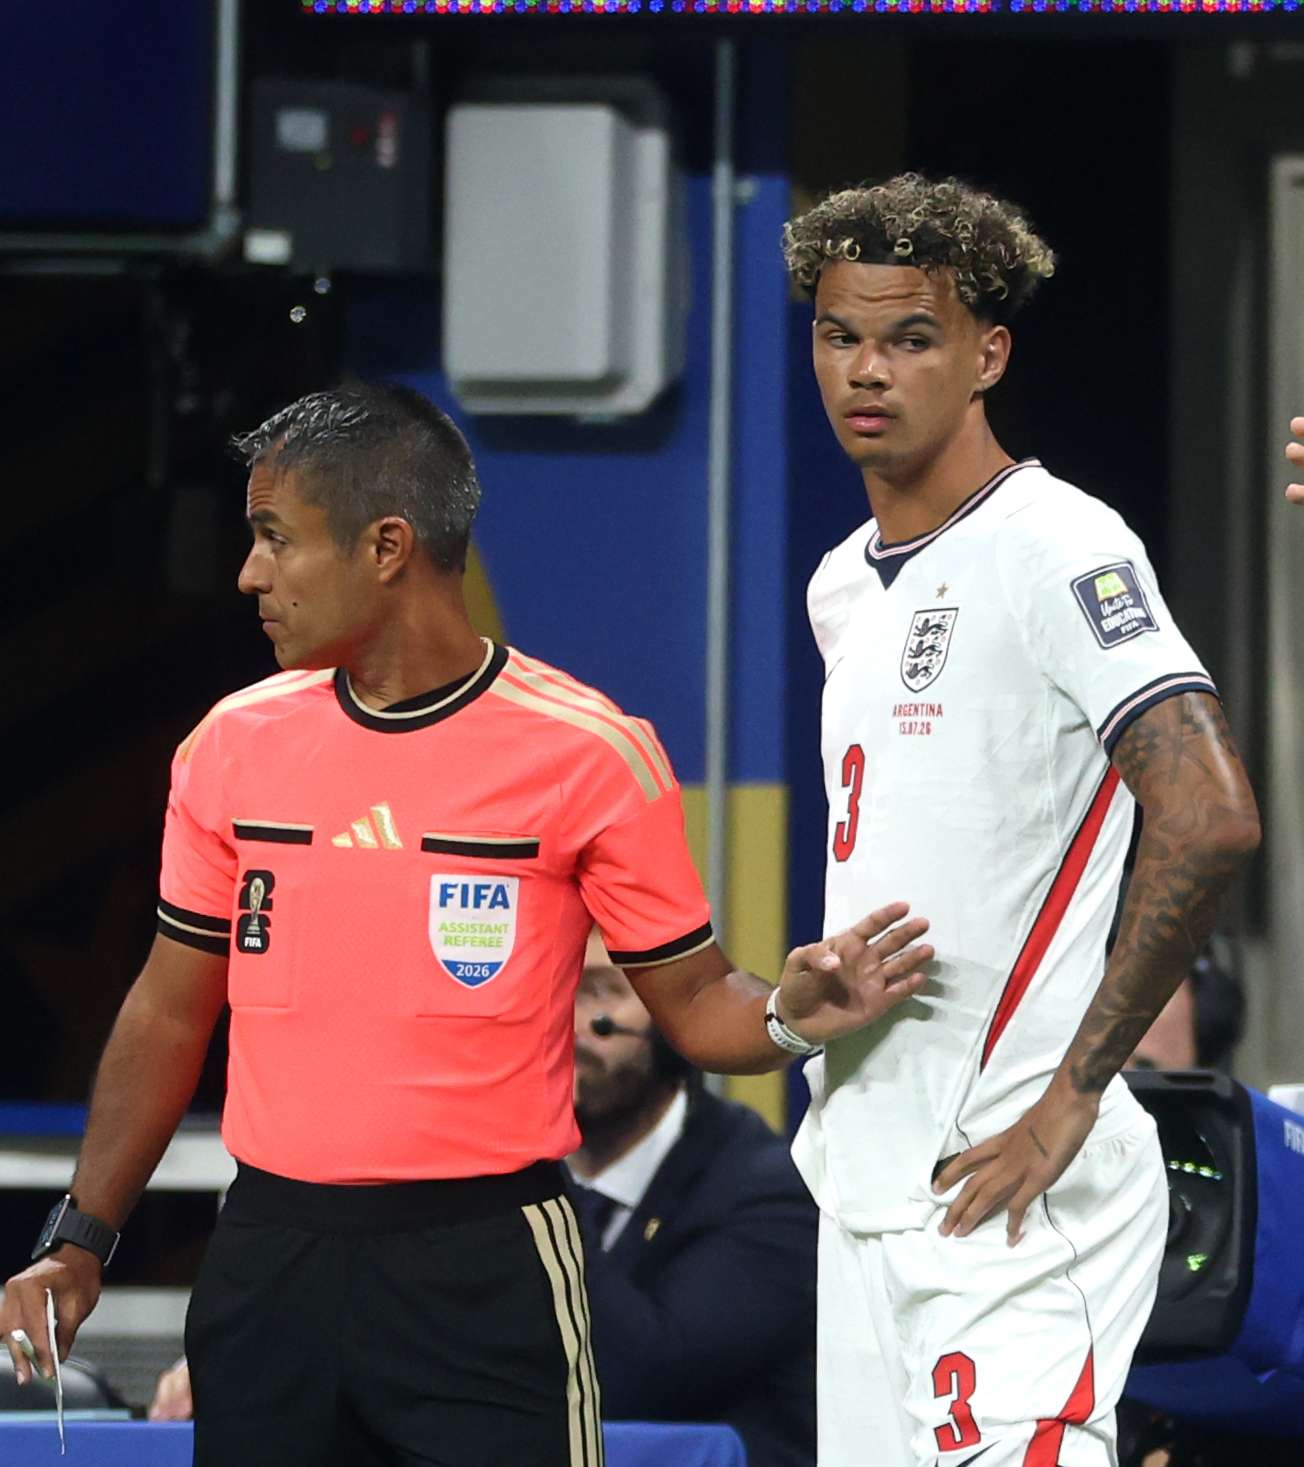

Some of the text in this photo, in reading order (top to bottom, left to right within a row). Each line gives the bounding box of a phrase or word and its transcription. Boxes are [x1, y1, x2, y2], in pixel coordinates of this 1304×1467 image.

[1120, 621, 1139, 634] FIFA
[892, 702, 944, 718] ARGENTINA
[899, 721, 932, 736] 15.07.26
[833, 744, 865, 862] 3
[439, 883, 510, 909] FIFA
[438, 922, 509, 934] ASSISTANT
[244, 936, 262, 948] FIFA
[443, 935, 504, 948] REFEREE
[456, 964, 490, 977] 2026
[931, 1350, 981, 1452] 3
